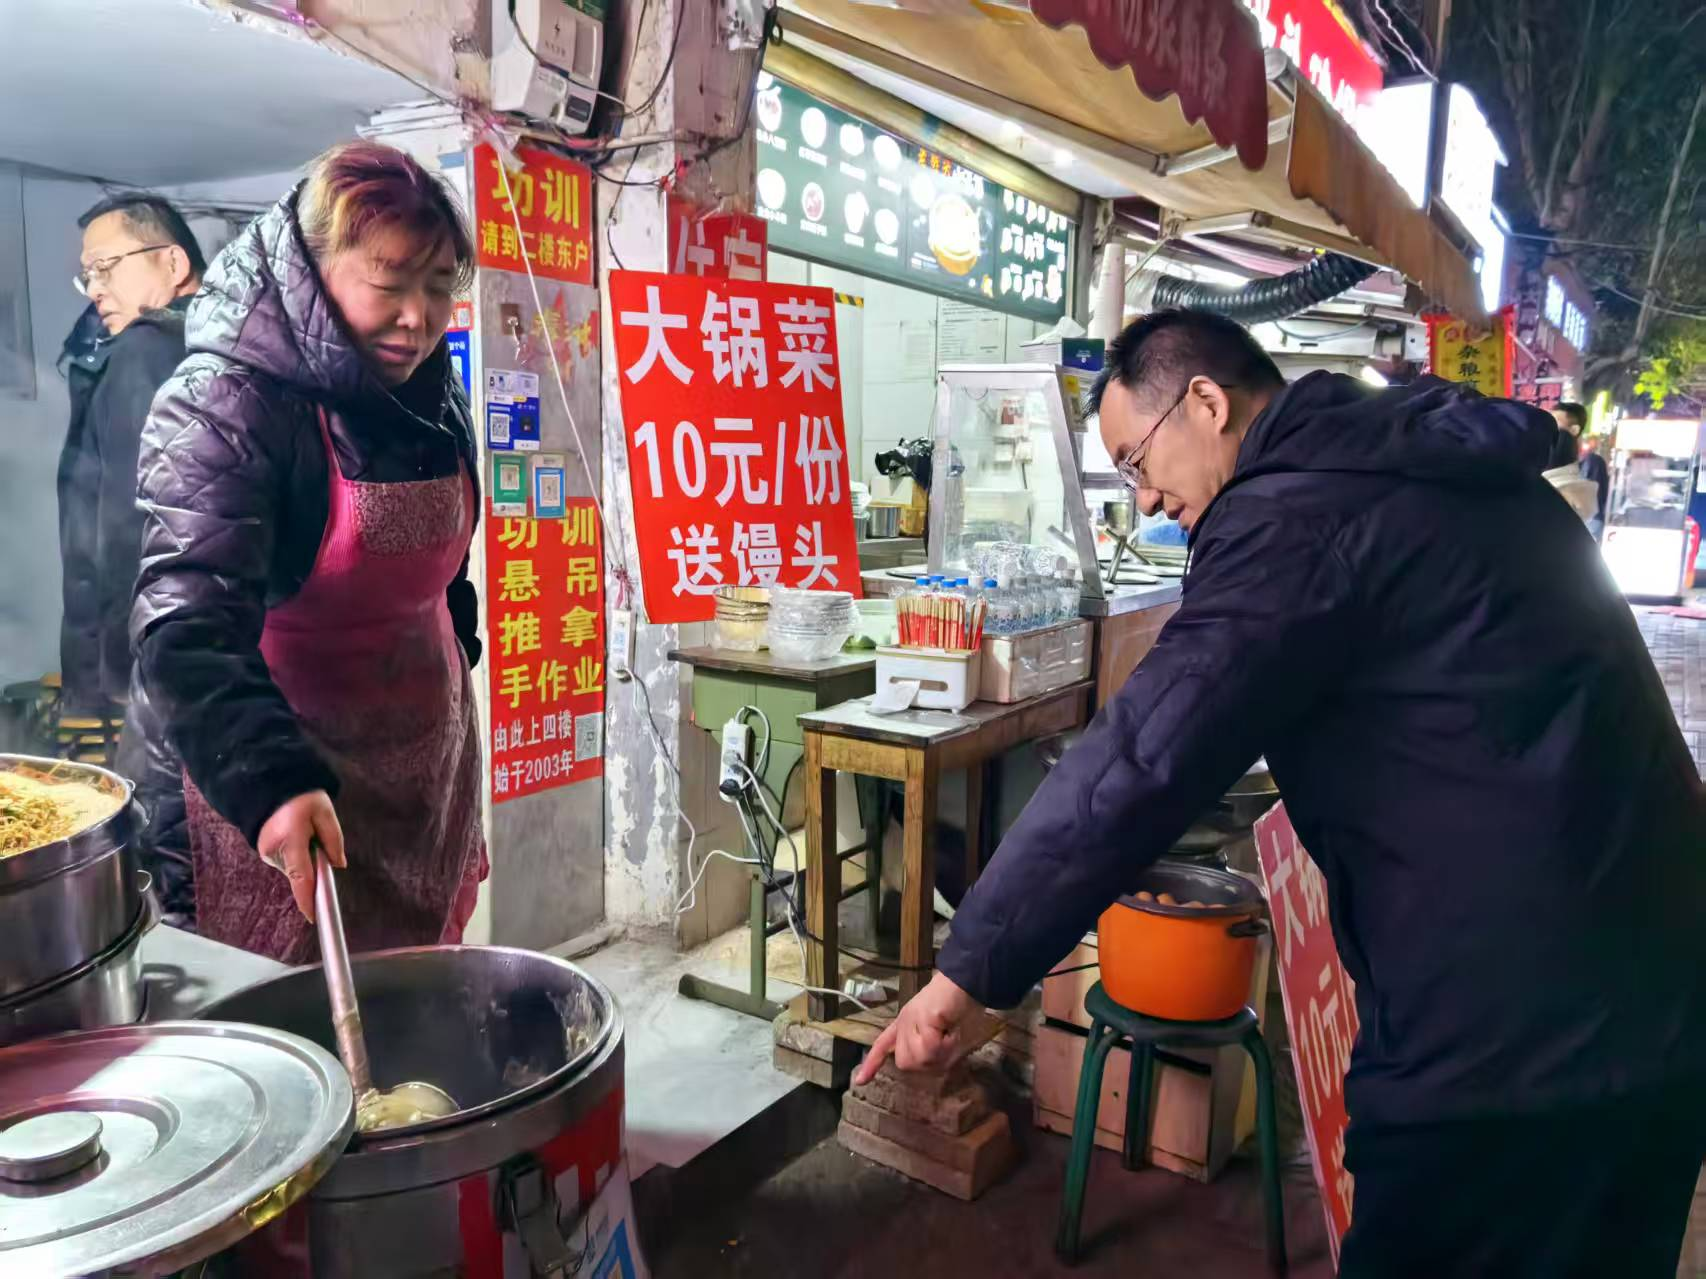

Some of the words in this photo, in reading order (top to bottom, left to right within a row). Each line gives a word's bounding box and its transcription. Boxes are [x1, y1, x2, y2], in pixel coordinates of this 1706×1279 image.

[481, 219, 588, 271] 请到二楼东户
[620, 285, 836, 393] 大锅菜
[634, 414, 843, 508] 10元/份
[498, 557, 599, 602] 悬吊
[667, 520, 840, 598] 送馒头
[499, 605, 599, 657] 推拿
[499, 656, 604, 709] 手作业
[494, 711, 572, 752] 由此上四楼
[494, 749, 574, 793] 始于2003年
